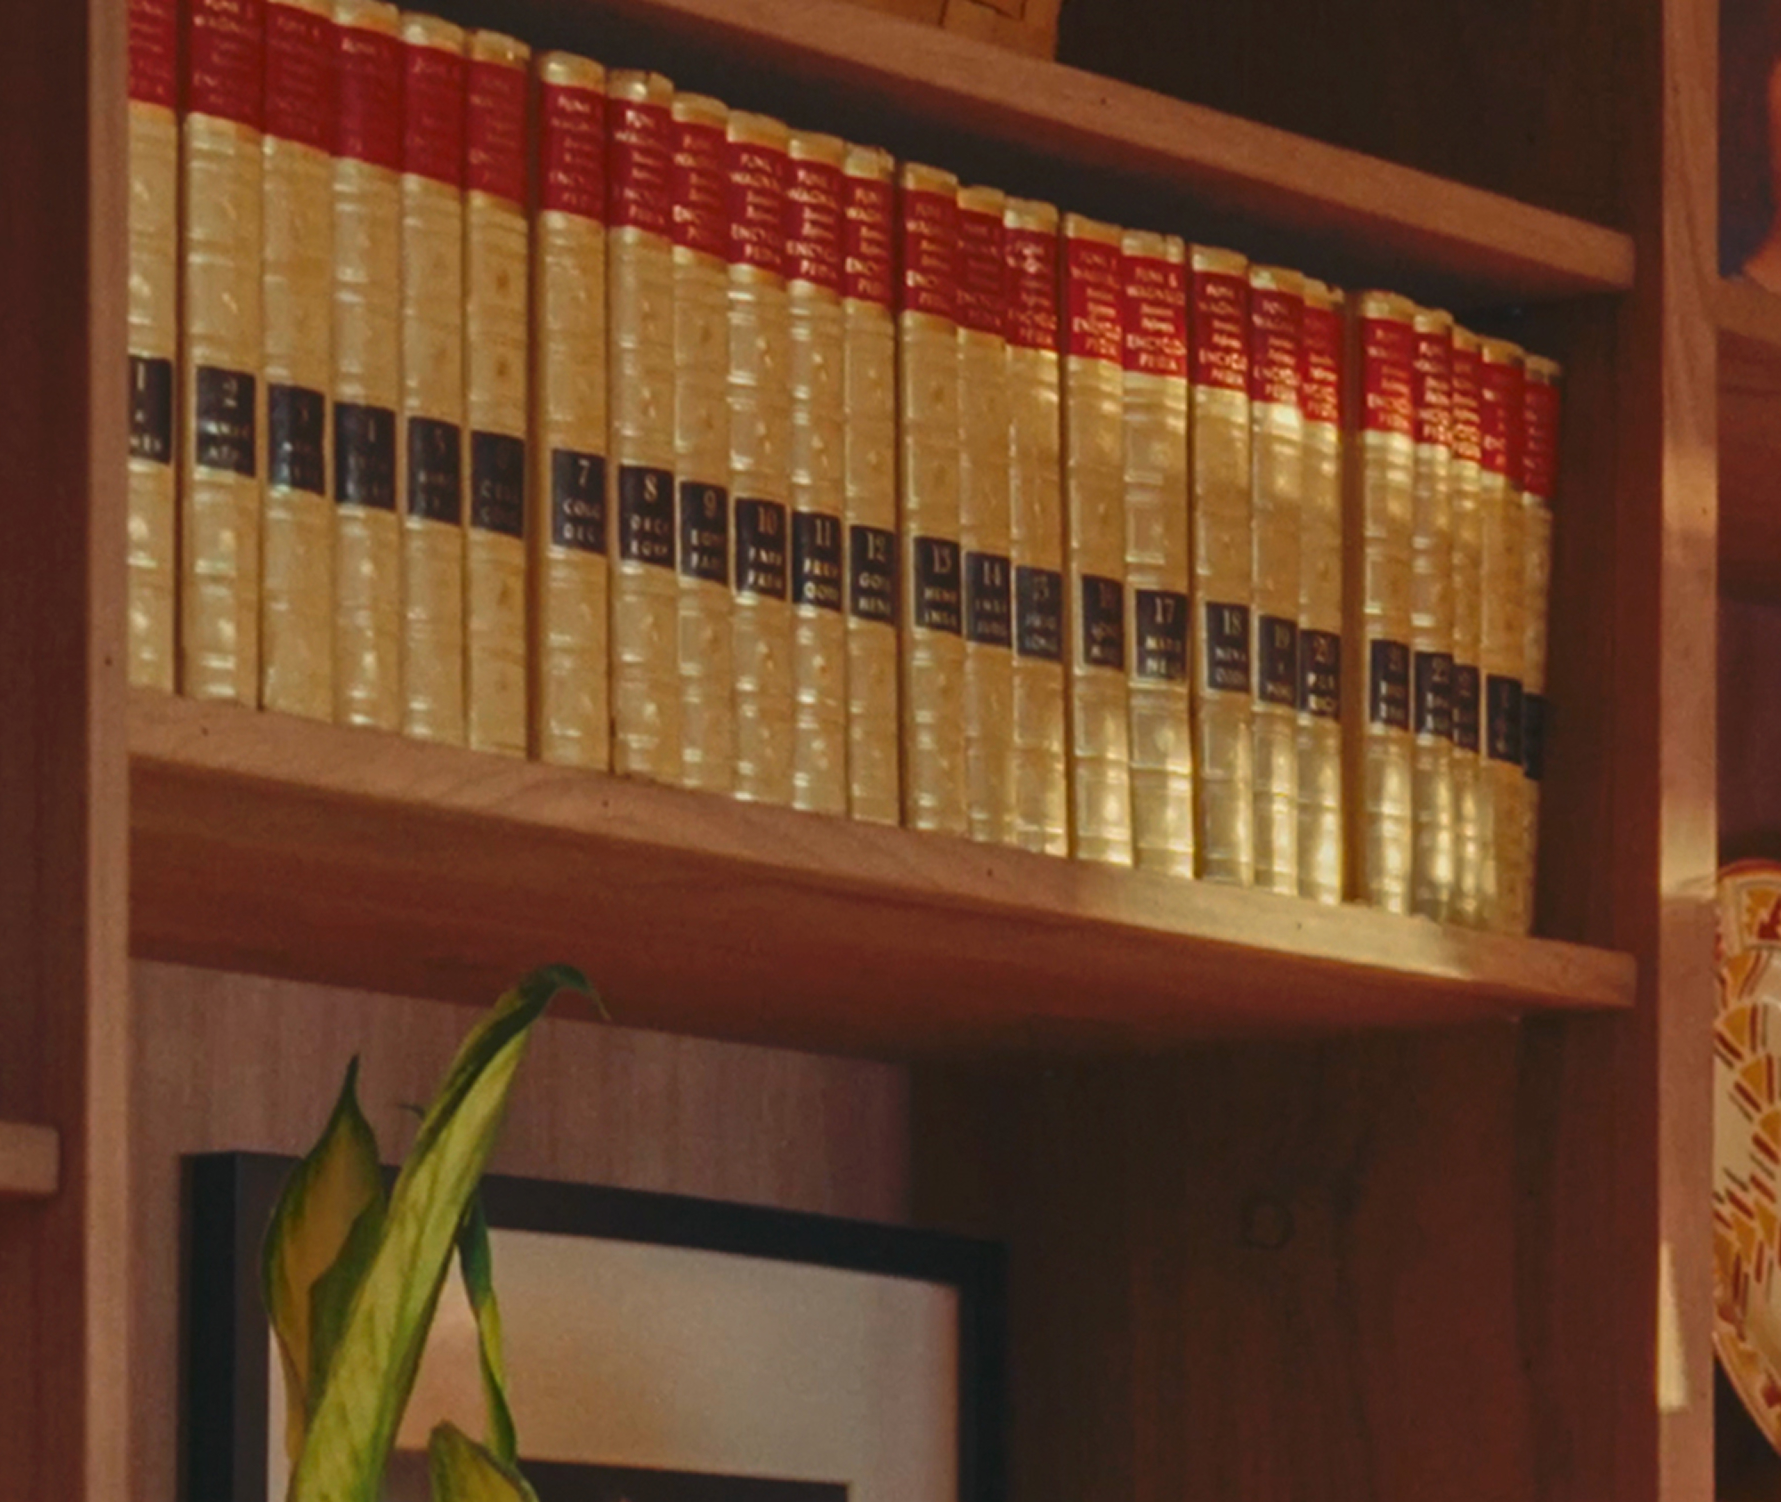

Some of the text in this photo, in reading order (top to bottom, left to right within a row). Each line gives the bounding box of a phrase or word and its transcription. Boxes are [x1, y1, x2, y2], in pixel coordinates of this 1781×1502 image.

[577, 458, 591, 488] 7
[643, 474, 658, 503] 8
[867, 532, 886, 562] 12
[1155, 596, 1175, 624] 17
[1223, 608, 1243, 636] 18
